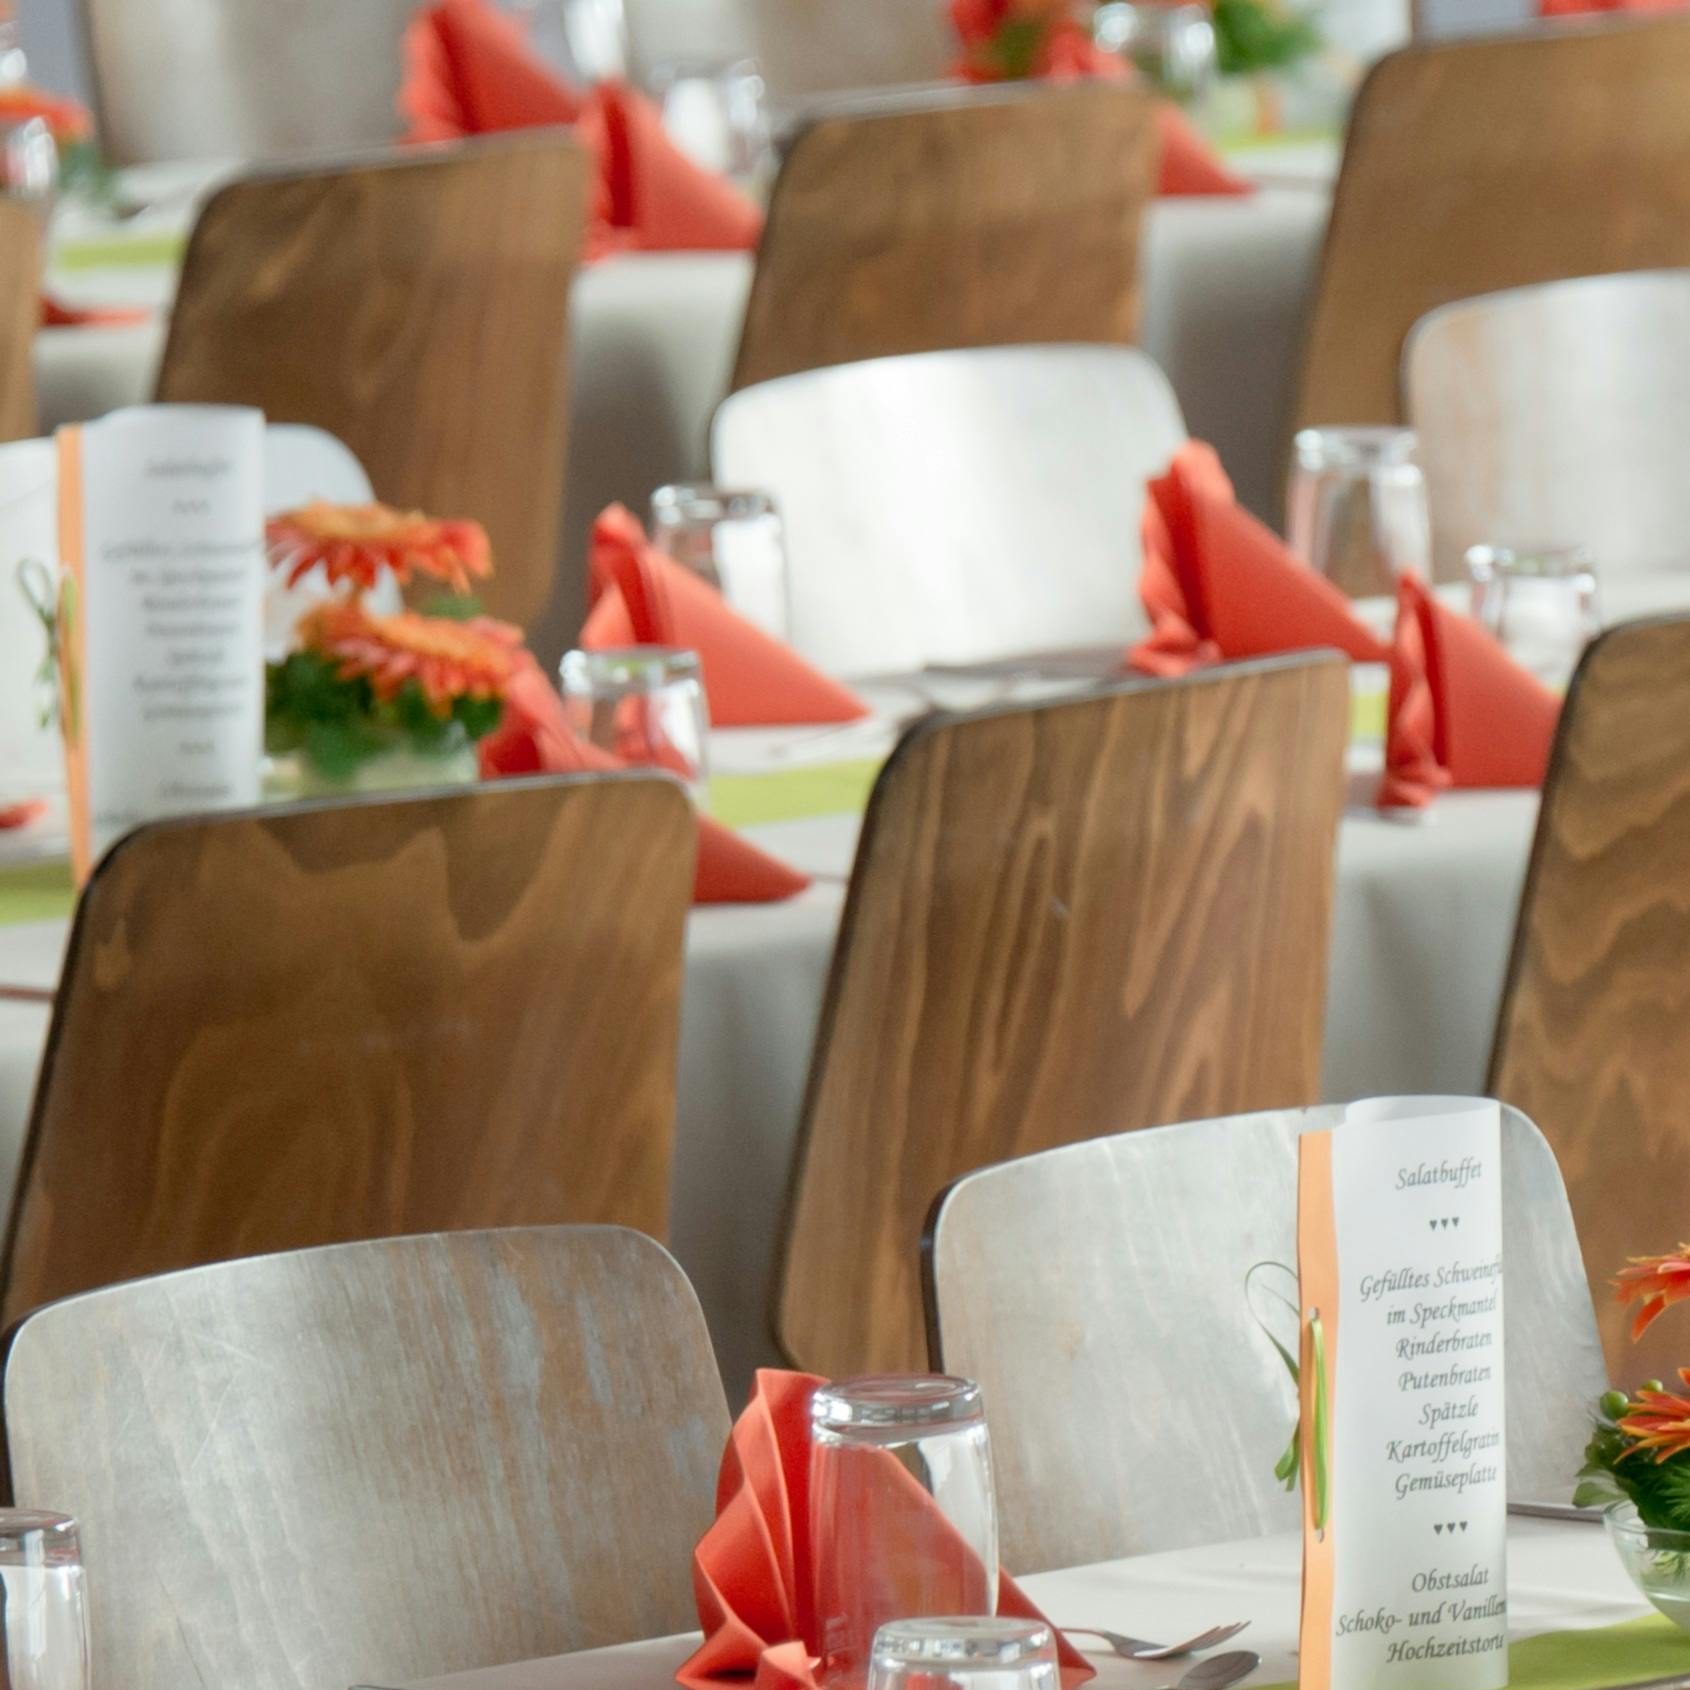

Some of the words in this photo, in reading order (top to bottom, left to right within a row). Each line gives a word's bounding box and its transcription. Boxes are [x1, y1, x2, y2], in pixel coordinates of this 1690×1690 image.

[1395, 1156, 1482, 1191] Salatbuffet
[1360, 1266, 1430, 1303] Gefülltes
[1387, 1304, 1406, 1326] im
[1396, 1329, 1492, 1360] Rinderbraten
[1398, 1363, 1492, 1392] Putenbraten
[1418, 1395, 1479, 1430] Spätzle
[1395, 1462, 1497, 1500] Gemüseplatte
[1411, 1563, 1489, 1593] Obstsalat
[1336, 1607, 1402, 1637] Schoko-
[1408, 1601, 1447, 1627] und
